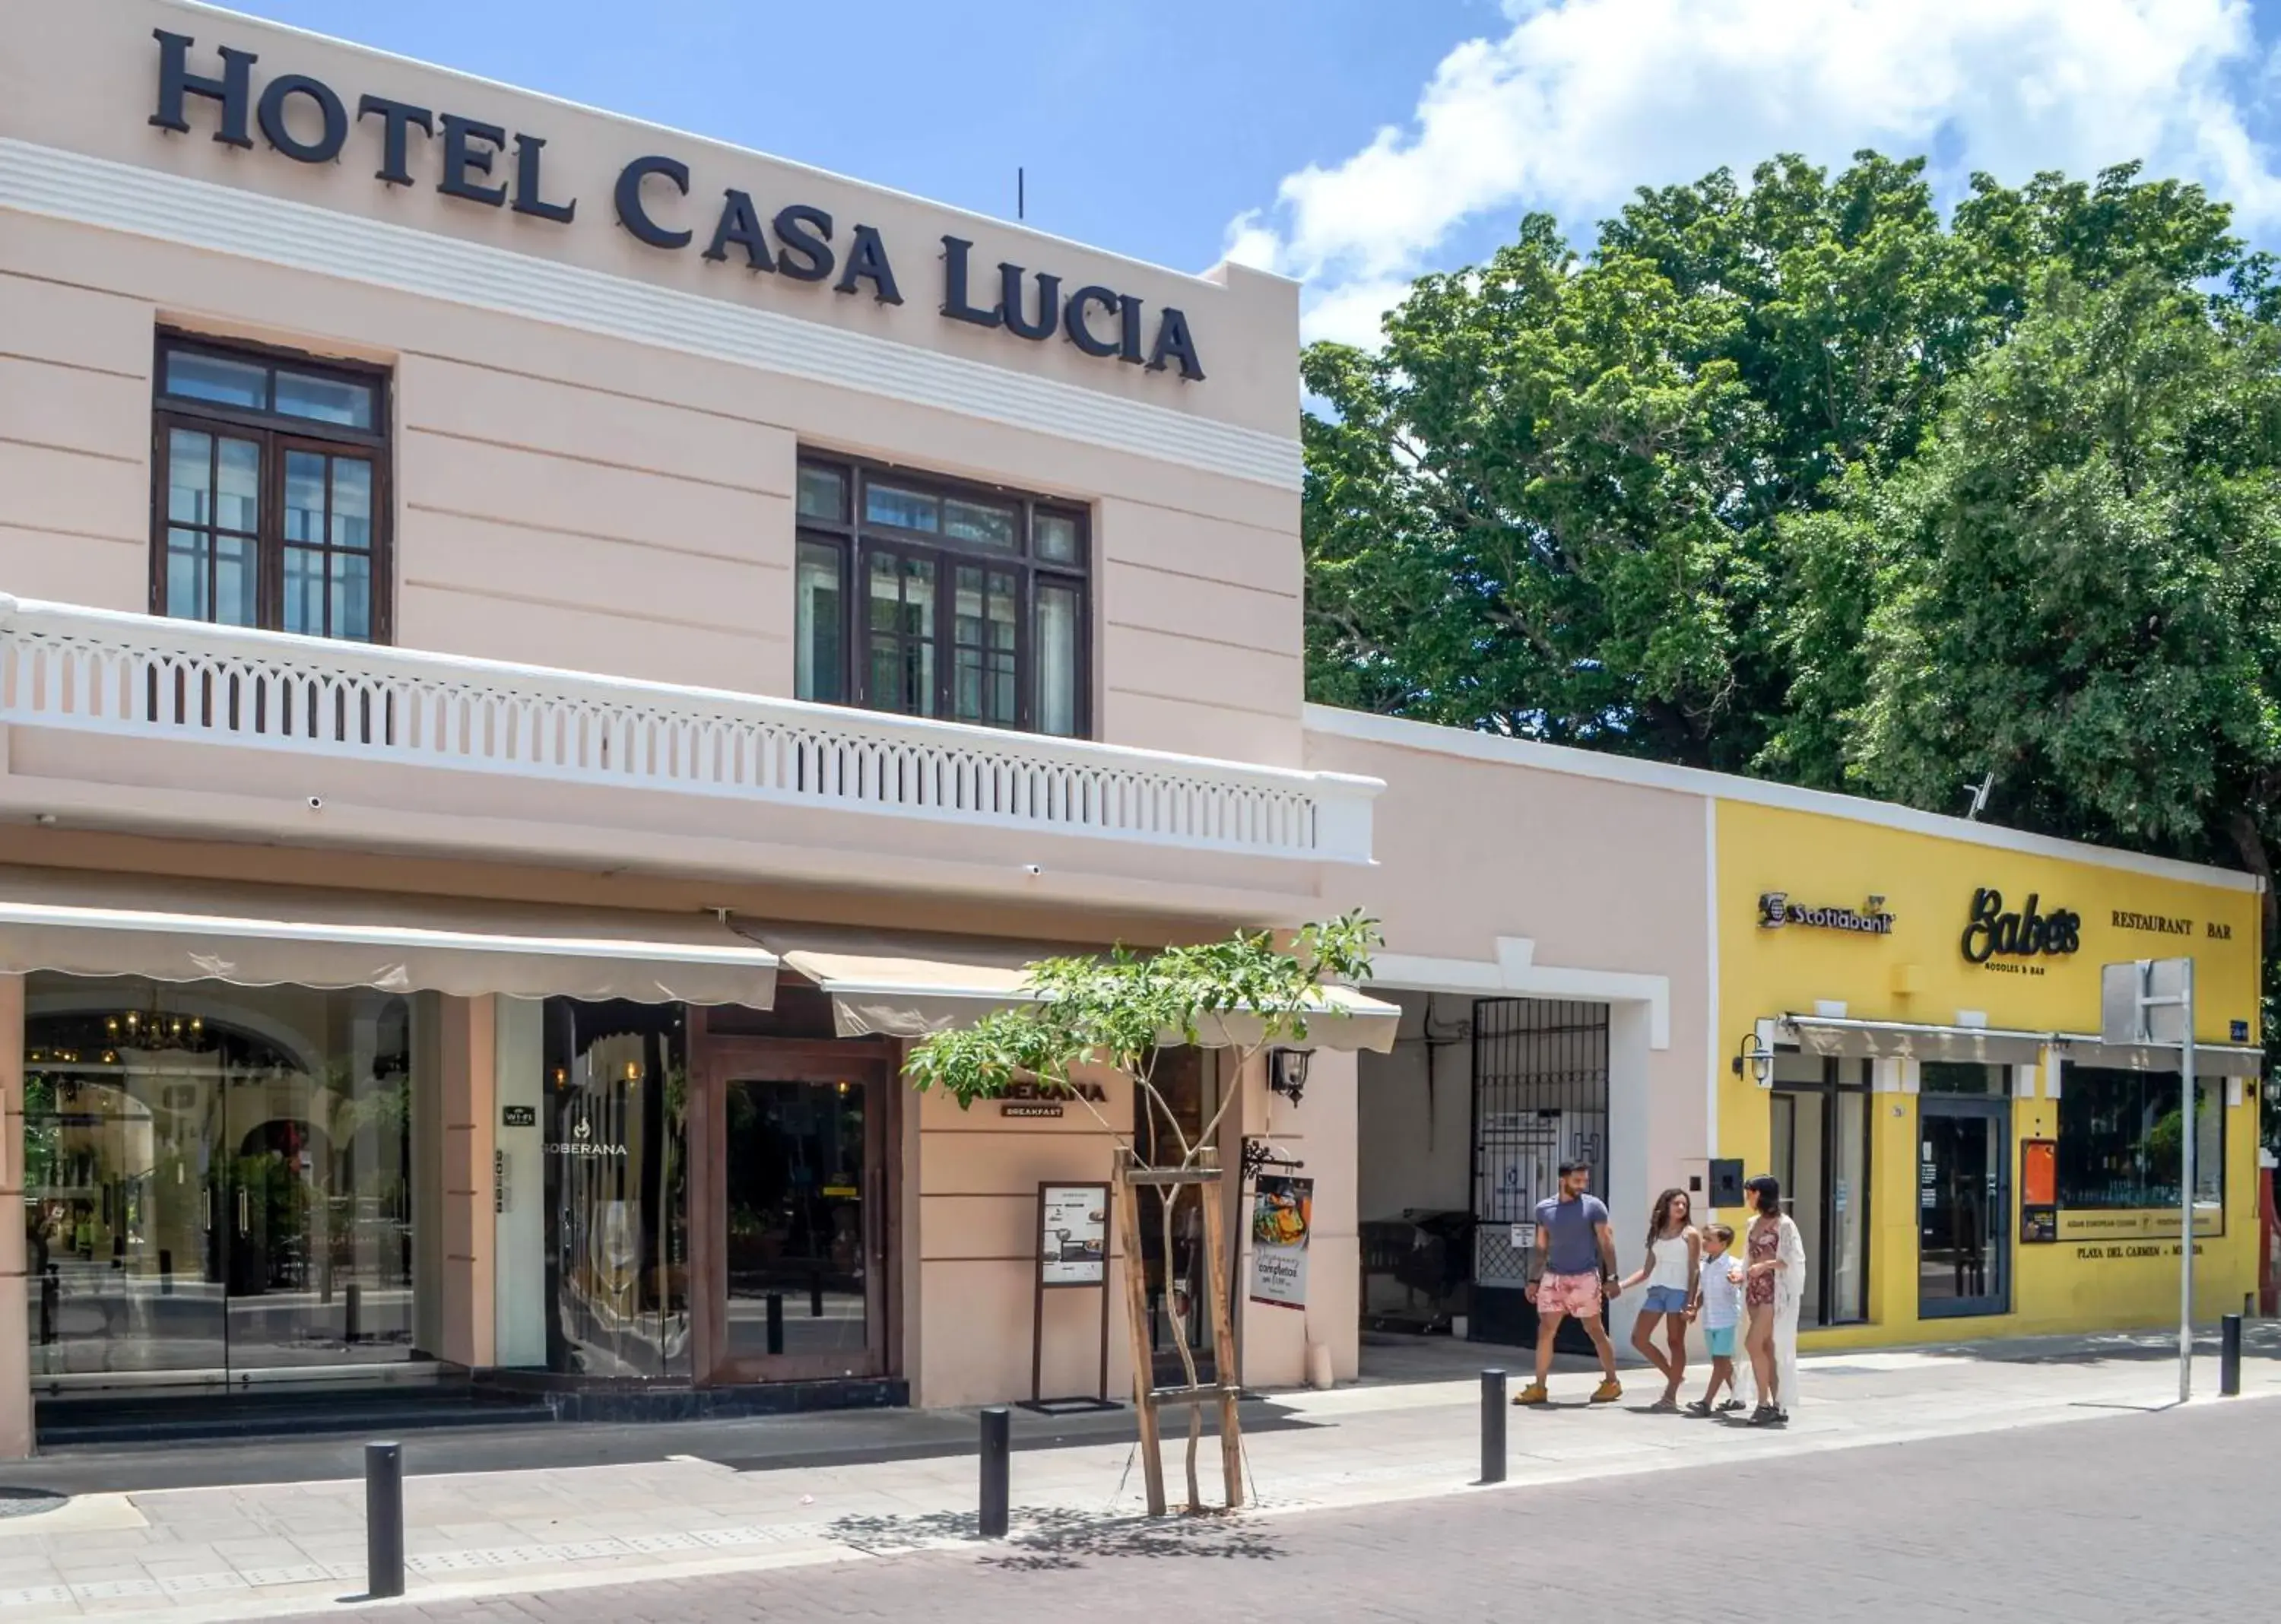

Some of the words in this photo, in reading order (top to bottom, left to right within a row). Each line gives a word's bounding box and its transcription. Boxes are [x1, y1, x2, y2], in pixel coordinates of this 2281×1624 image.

[148, 27, 576, 224] HOTEL
[613, 155, 904, 306] CASA
[939, 234, 1206, 382] LUCIA
[1790, 905, 1892, 934] Scotiabank
[2111, 910, 2194, 936] RESTAURANT
[2206, 921, 2232, 940] BAR
[1984, 963, 2019, 974] NOODLES
[2030, 966, 2045, 975] BAR
[1006, 1107, 1061, 1116] BREAKFAST
[541, 1143, 627, 1155] SOBERANA
[2077, 1247, 2104, 1259] PLAYA
[2107, 1246, 2124, 1258] DEL
[2126, 1245, 2160, 1257] CARMEN
